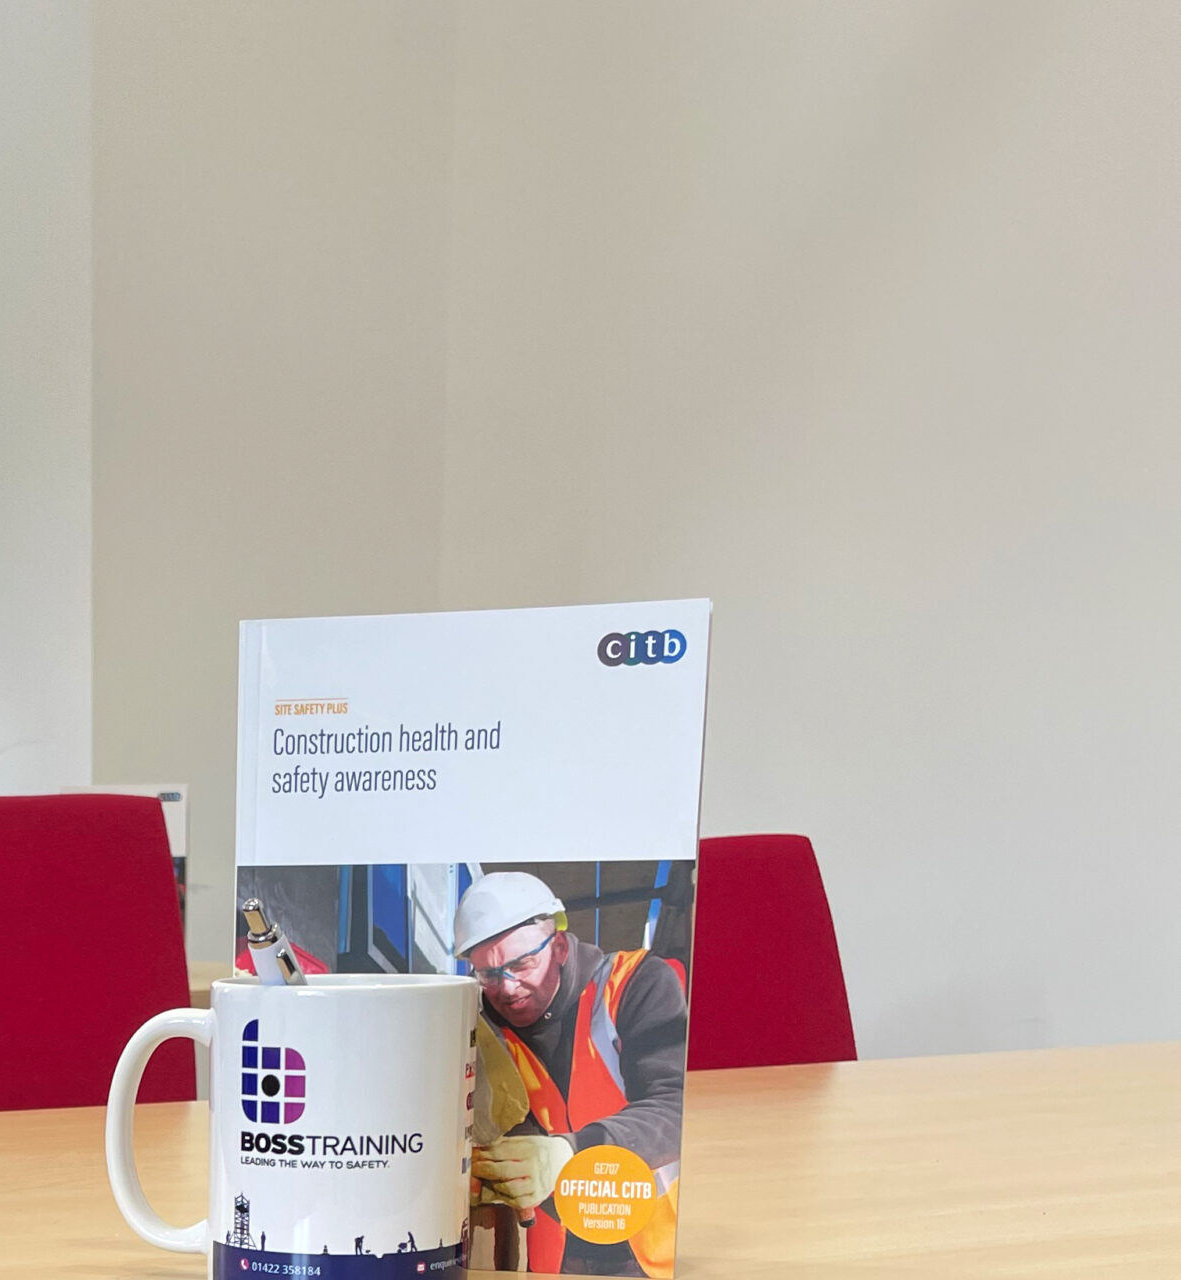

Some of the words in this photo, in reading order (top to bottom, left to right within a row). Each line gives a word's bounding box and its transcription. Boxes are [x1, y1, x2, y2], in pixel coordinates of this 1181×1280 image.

[606, 633, 681, 659] citb
[274, 704, 292, 716] SITE
[294, 703, 325, 716] SAFETY
[326, 702, 348, 714] PLUS
[273, 725, 392, 756] Construction
[399, 723, 458, 752] health
[464, 721, 501, 750] and
[272, 765, 329, 799] safety
[334, 769, 437, 792] awareness
[240, 1156, 276, 1167] LEADING
[279, 1159, 297, 1168] THE
[300, 1160, 326, 1169] WAY
[329, 1160, 343, 1169] TO
[594, 1162, 620, 1175] GE707
[560, 1179, 619, 1198] OFFICIAL
[622, 1182, 652, 1199] CITB
[578, 1202, 631, 1216] PUBLICATION
[582, 1217, 614, 1229] Version
[251, 1261, 280, 1274] 01422
[282, 1264, 321, 1276] 358184
